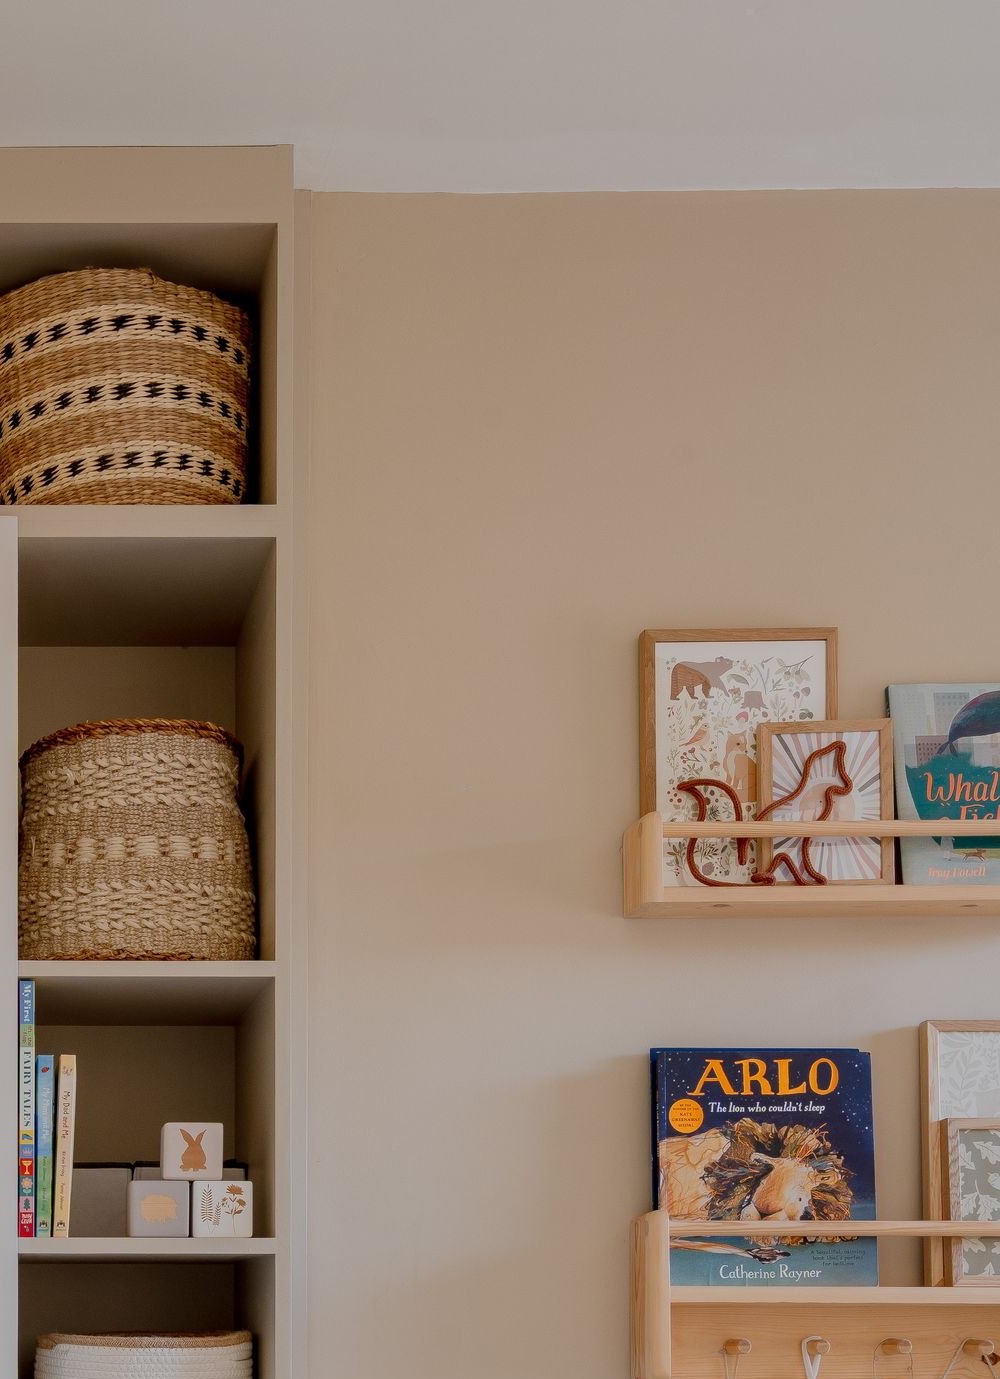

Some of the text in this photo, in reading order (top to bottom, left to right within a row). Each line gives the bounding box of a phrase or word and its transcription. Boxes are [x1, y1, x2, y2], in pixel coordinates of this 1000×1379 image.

[923, 771, 1000, 802] Whal
[23, 984, 31, 1022] My First
[23, 1051, 32, 1127] FAIRY TALES
[686, 1057, 840, 1096] ARLO
[62, 1090, 70, 1100] My
[708, 1101, 826, 1114] The lion who couldn't sleep
[60, 1129, 69, 1140] Me
[719, 1263, 822, 1282] Catherine Rayner
